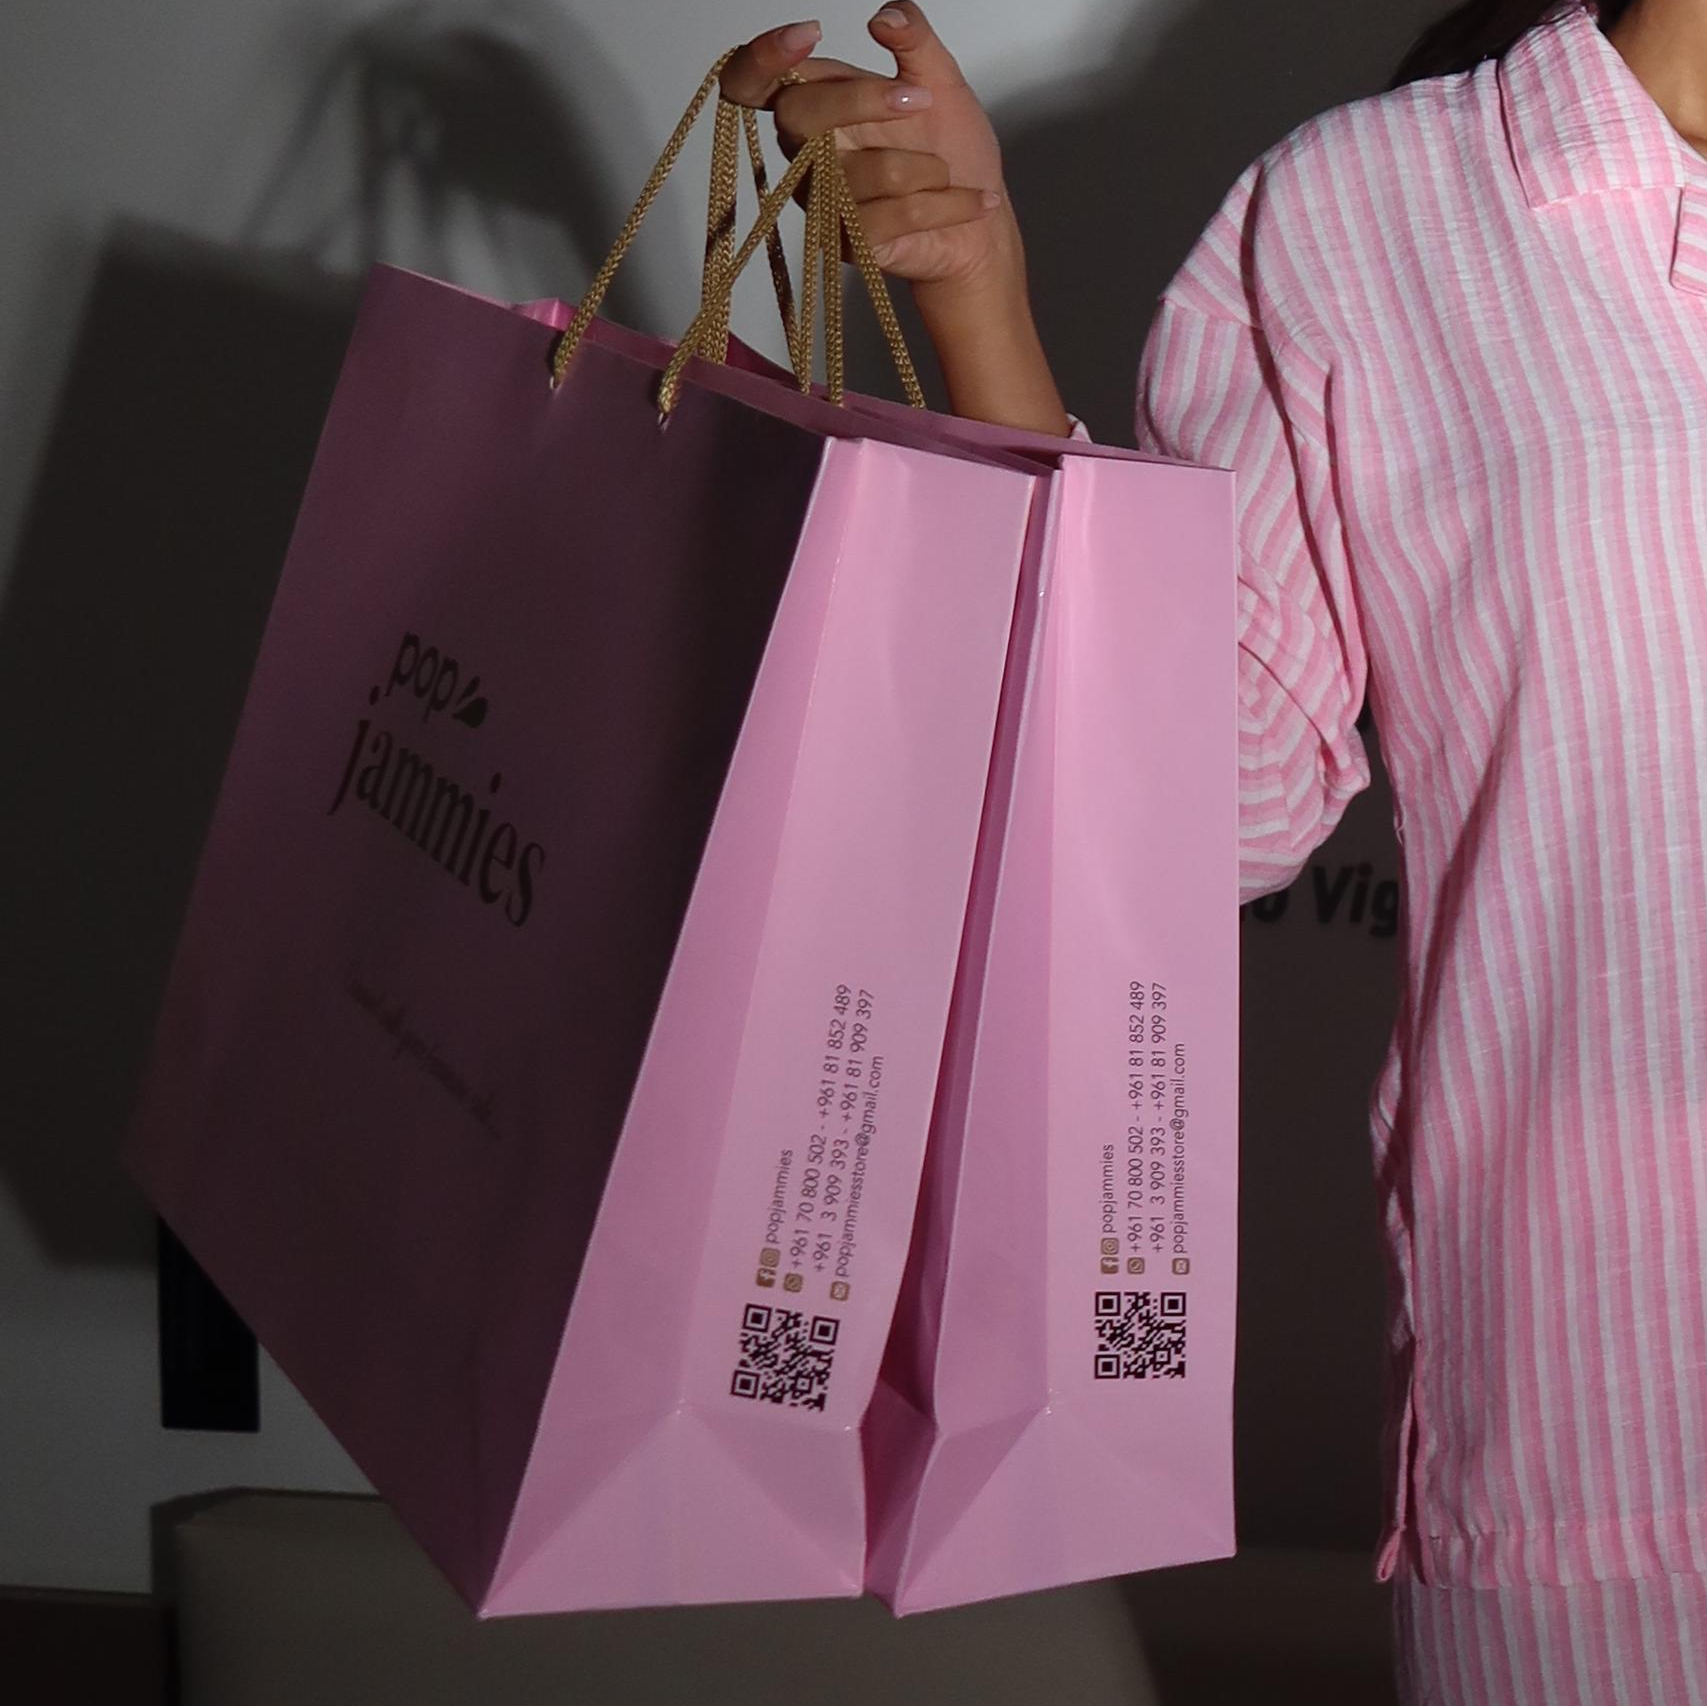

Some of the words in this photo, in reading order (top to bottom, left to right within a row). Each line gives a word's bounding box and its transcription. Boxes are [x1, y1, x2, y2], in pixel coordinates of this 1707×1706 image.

[387, 631, 460, 723] pop
[327, 684, 547, 928] jammies
[833, 984, 851, 1015] 489
[856, 989, 874, 1020] 397
[1130, 981, 1144, 1011] 489
[1152, 983, 1167, 1010] 397
[827, 1019, 846, 1050] 852
[850, 1023, 868, 1053] 909
[1129, 1015, 1144, 1043] 852
[1151, 1014, 1166, 1043] 909
[823, 1055, 840, 1074] 81
[845, 1060, 862, 1078] 81
[1129, 1050, 1144, 1067] 81
[1151, 1051, 1166, 1067] 81
[817, 1080, 836, 1118] +961
[840, 1084, 858, 1122] +961
[1128, 1074, 1144, 1110] +961
[1151, 1074, 1166, 1110] +961
[808, 1134, 826, 1164] 502
[831, 1139, 849, 1170] 393
[1128, 1126, 1143, 1154] 502
[1151, 1127, 1165, 1157] 393
[1169, 1044, 1189, 1254] popjammiesstore@gmail.com
[835, 1056, 884, 1277] popjammiesstore@gmail.com
[1128, 1158, 1143, 1186] 800
[1150, 1161, 1165, 1190] 909
[766, 1149, 793, 1244] popjammies
[801, 1168, 820, 1198] 800
[824, 1174, 842, 1205] 909
[1099, 1144, 1117, 1233] popjammies
[796, 1202, 814, 1221] 70
[1128, 1190, 1143, 1209] 70
[1150, 1195, 1165, 1205] 3
[821, 1211, 837, 1221] 3
[791, 1229, 810, 1269] +961
[1127, 1216, 1143, 1252] +961
[1150, 1217, 1165, 1253] +961
[813, 1233, 832, 1272] +961
